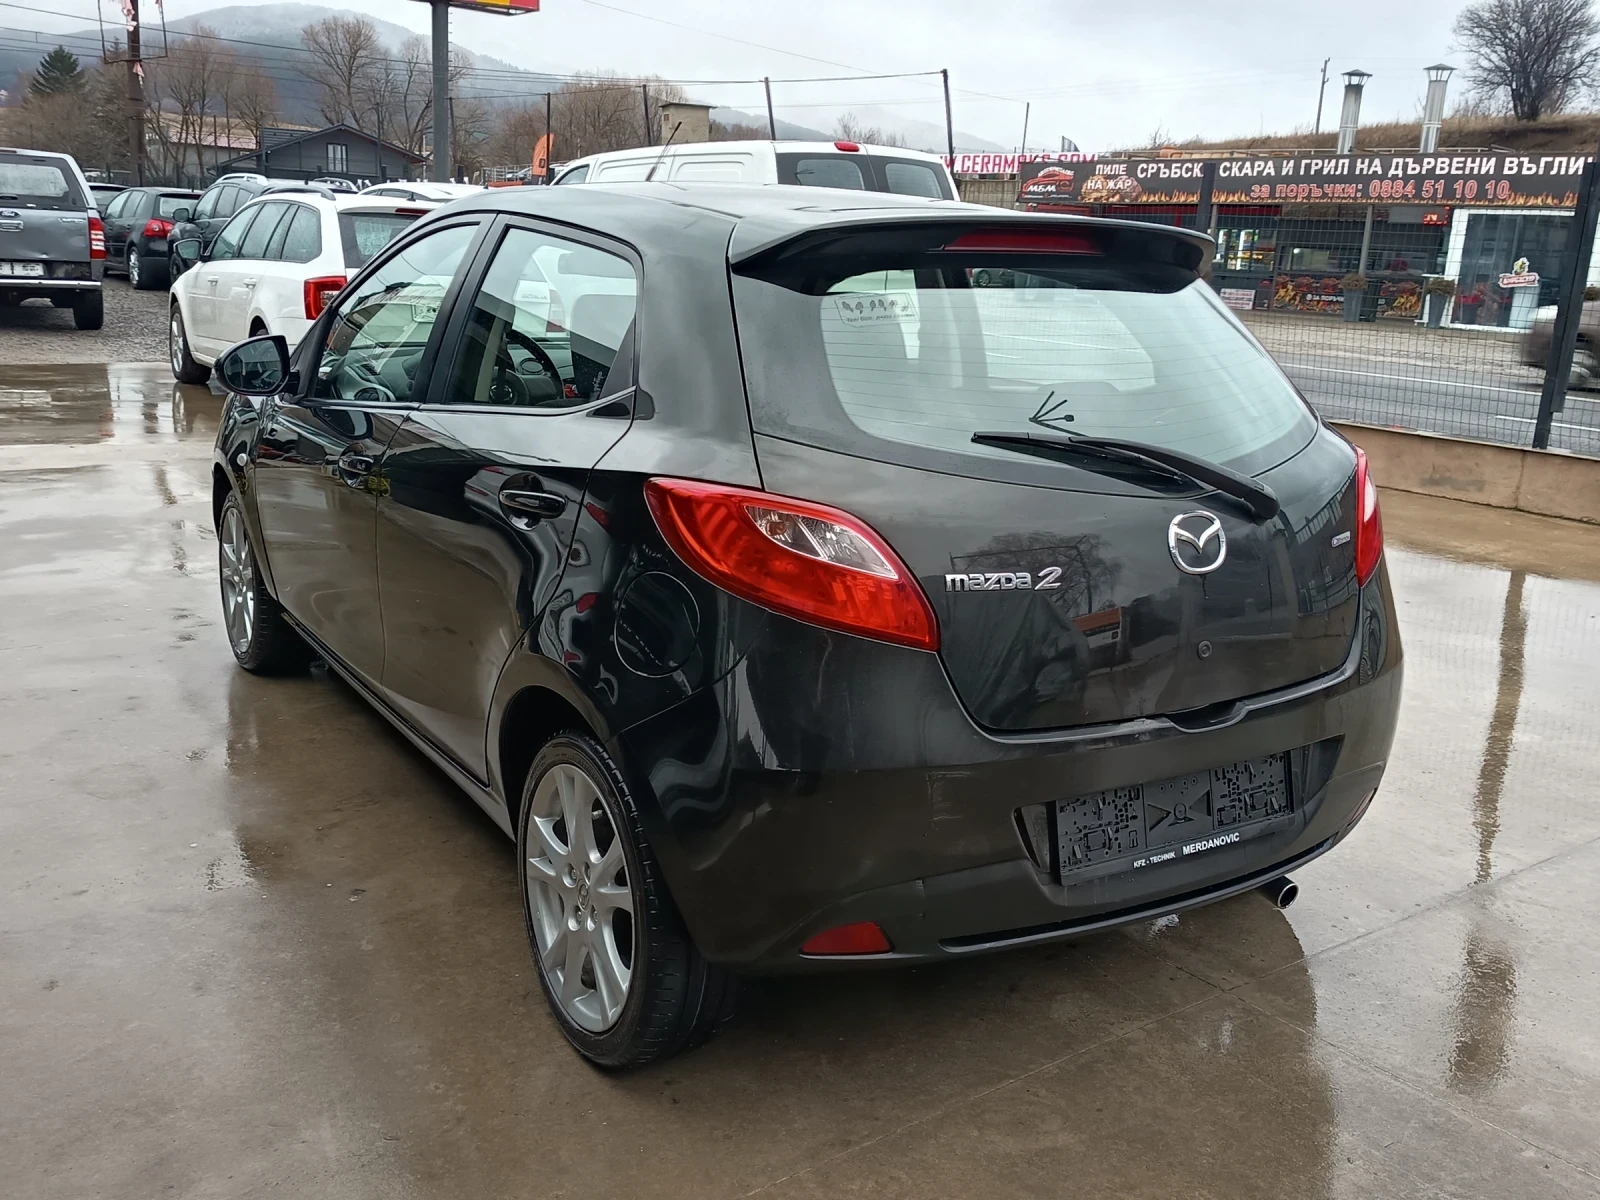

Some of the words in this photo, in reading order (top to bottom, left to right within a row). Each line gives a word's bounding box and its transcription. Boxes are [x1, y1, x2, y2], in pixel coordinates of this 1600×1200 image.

[1095, 164, 1127, 175] ПИЛЕ
[1219, 160, 1276, 177] СКАРА
[1281, 159, 1294, 176] И
[1300, 158, 1350, 175] ГРИЛ
[1355, 158, 1383, 175] НА
[1388, 156, 1496, 178] ДЪРВЕНИ
[1087, 179, 1103, 190] НА
[1106, 179, 1132, 190] ЖАР
[1250, 184, 1271, 198] за
[1276, 183, 1363, 201] поръчки:
[1369, 179, 1416, 198] 0884
[1421, 179, 1445, 198] 51
[1453, 179, 1478, 199] 10
[1485, 179, 1511, 200] 10
[1133, 859, 1146, 868] KFZ
[1150, 852, 1176, 864] TECHNIK
[1182, 833, 1240, 855] MERDANOVIC
